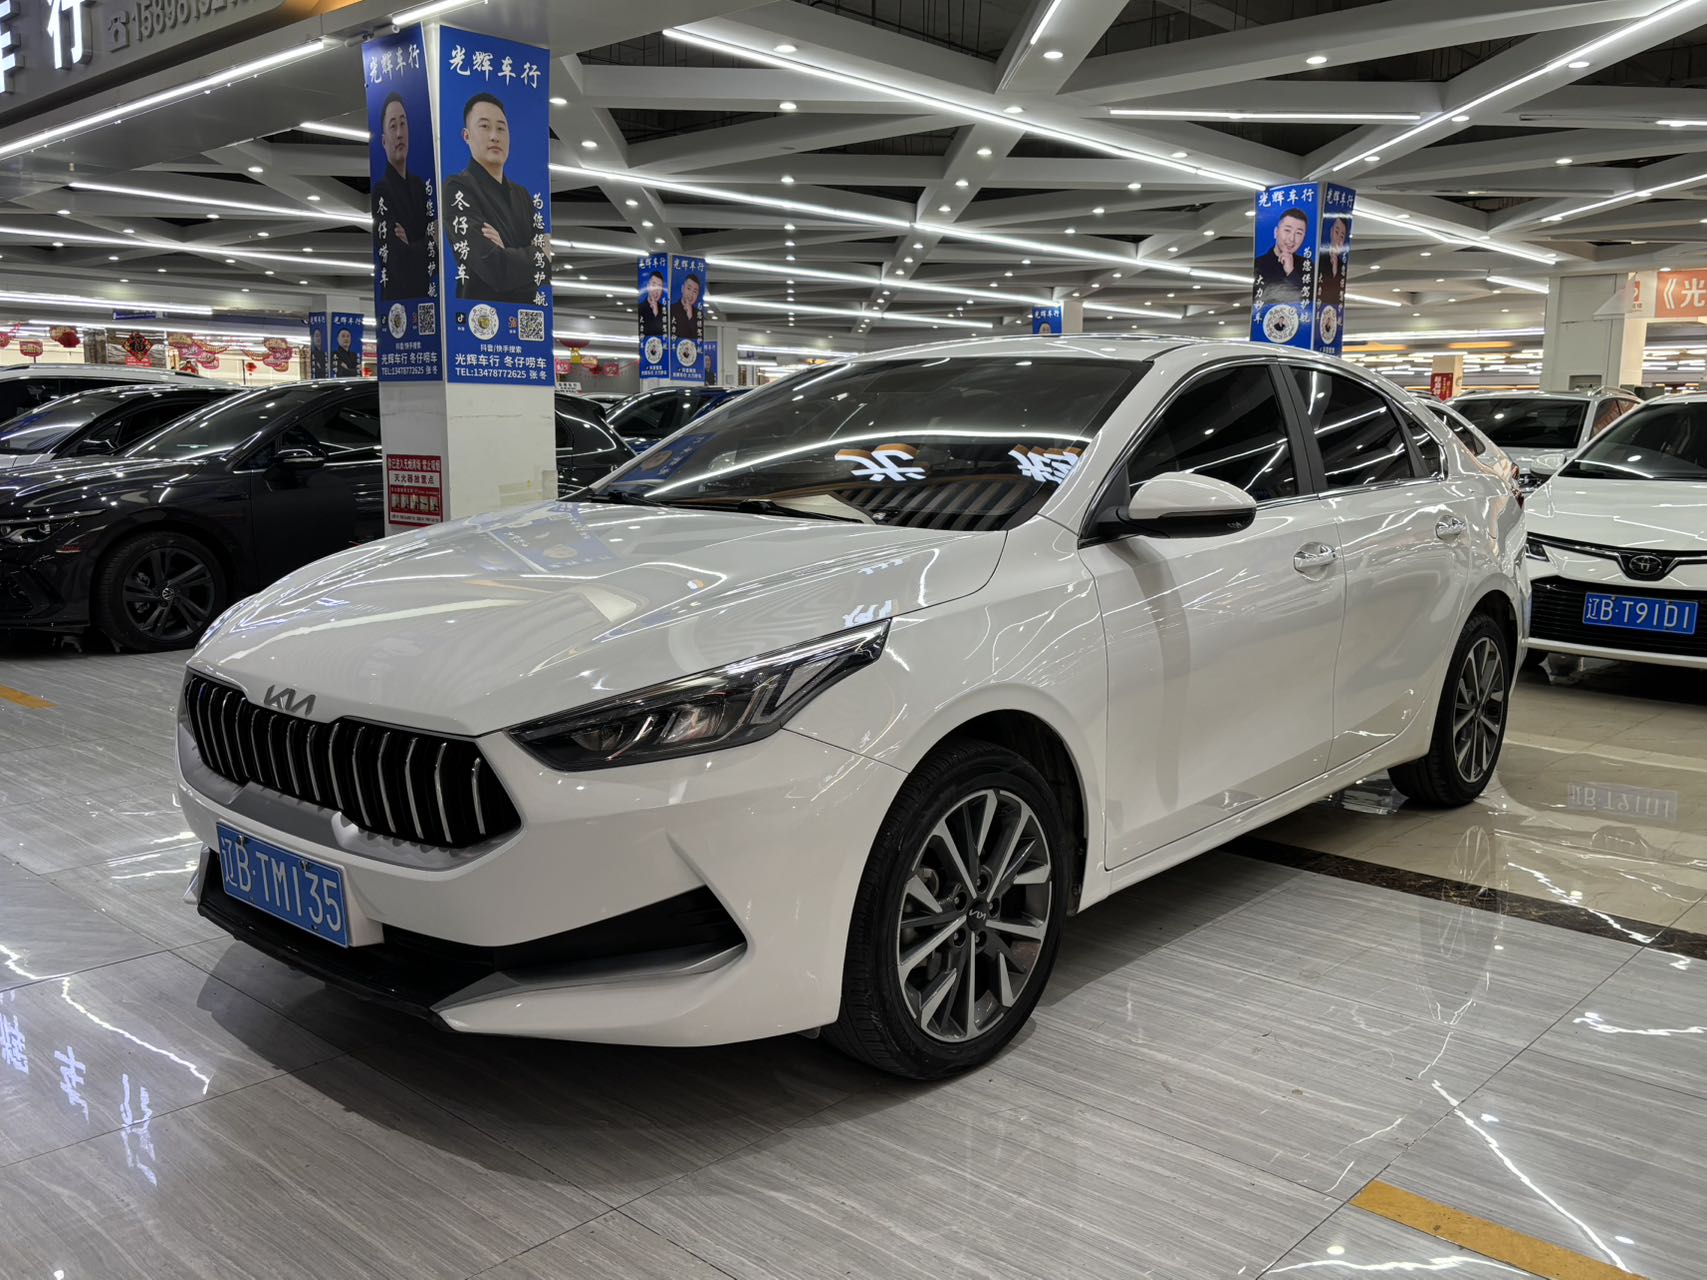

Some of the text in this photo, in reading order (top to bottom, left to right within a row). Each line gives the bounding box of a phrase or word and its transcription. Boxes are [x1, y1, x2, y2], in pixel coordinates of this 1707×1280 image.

[369, 44, 420, 84] 光辉车行
[449, 45, 542, 89] 光辉车行
[1257, 188, 1315, 207] 光辉车行
[425, 178, 438, 298] 为您保驾护航
[450, 190, 470, 286] 冬仔唠车
[532, 192, 549, 307] 为您保驾护航
[455, 353, 500, 367] 光辉车行
[504, 355, 547, 368] 冬仔唠车
[455, 367, 527, 379] TEL:13478772625
